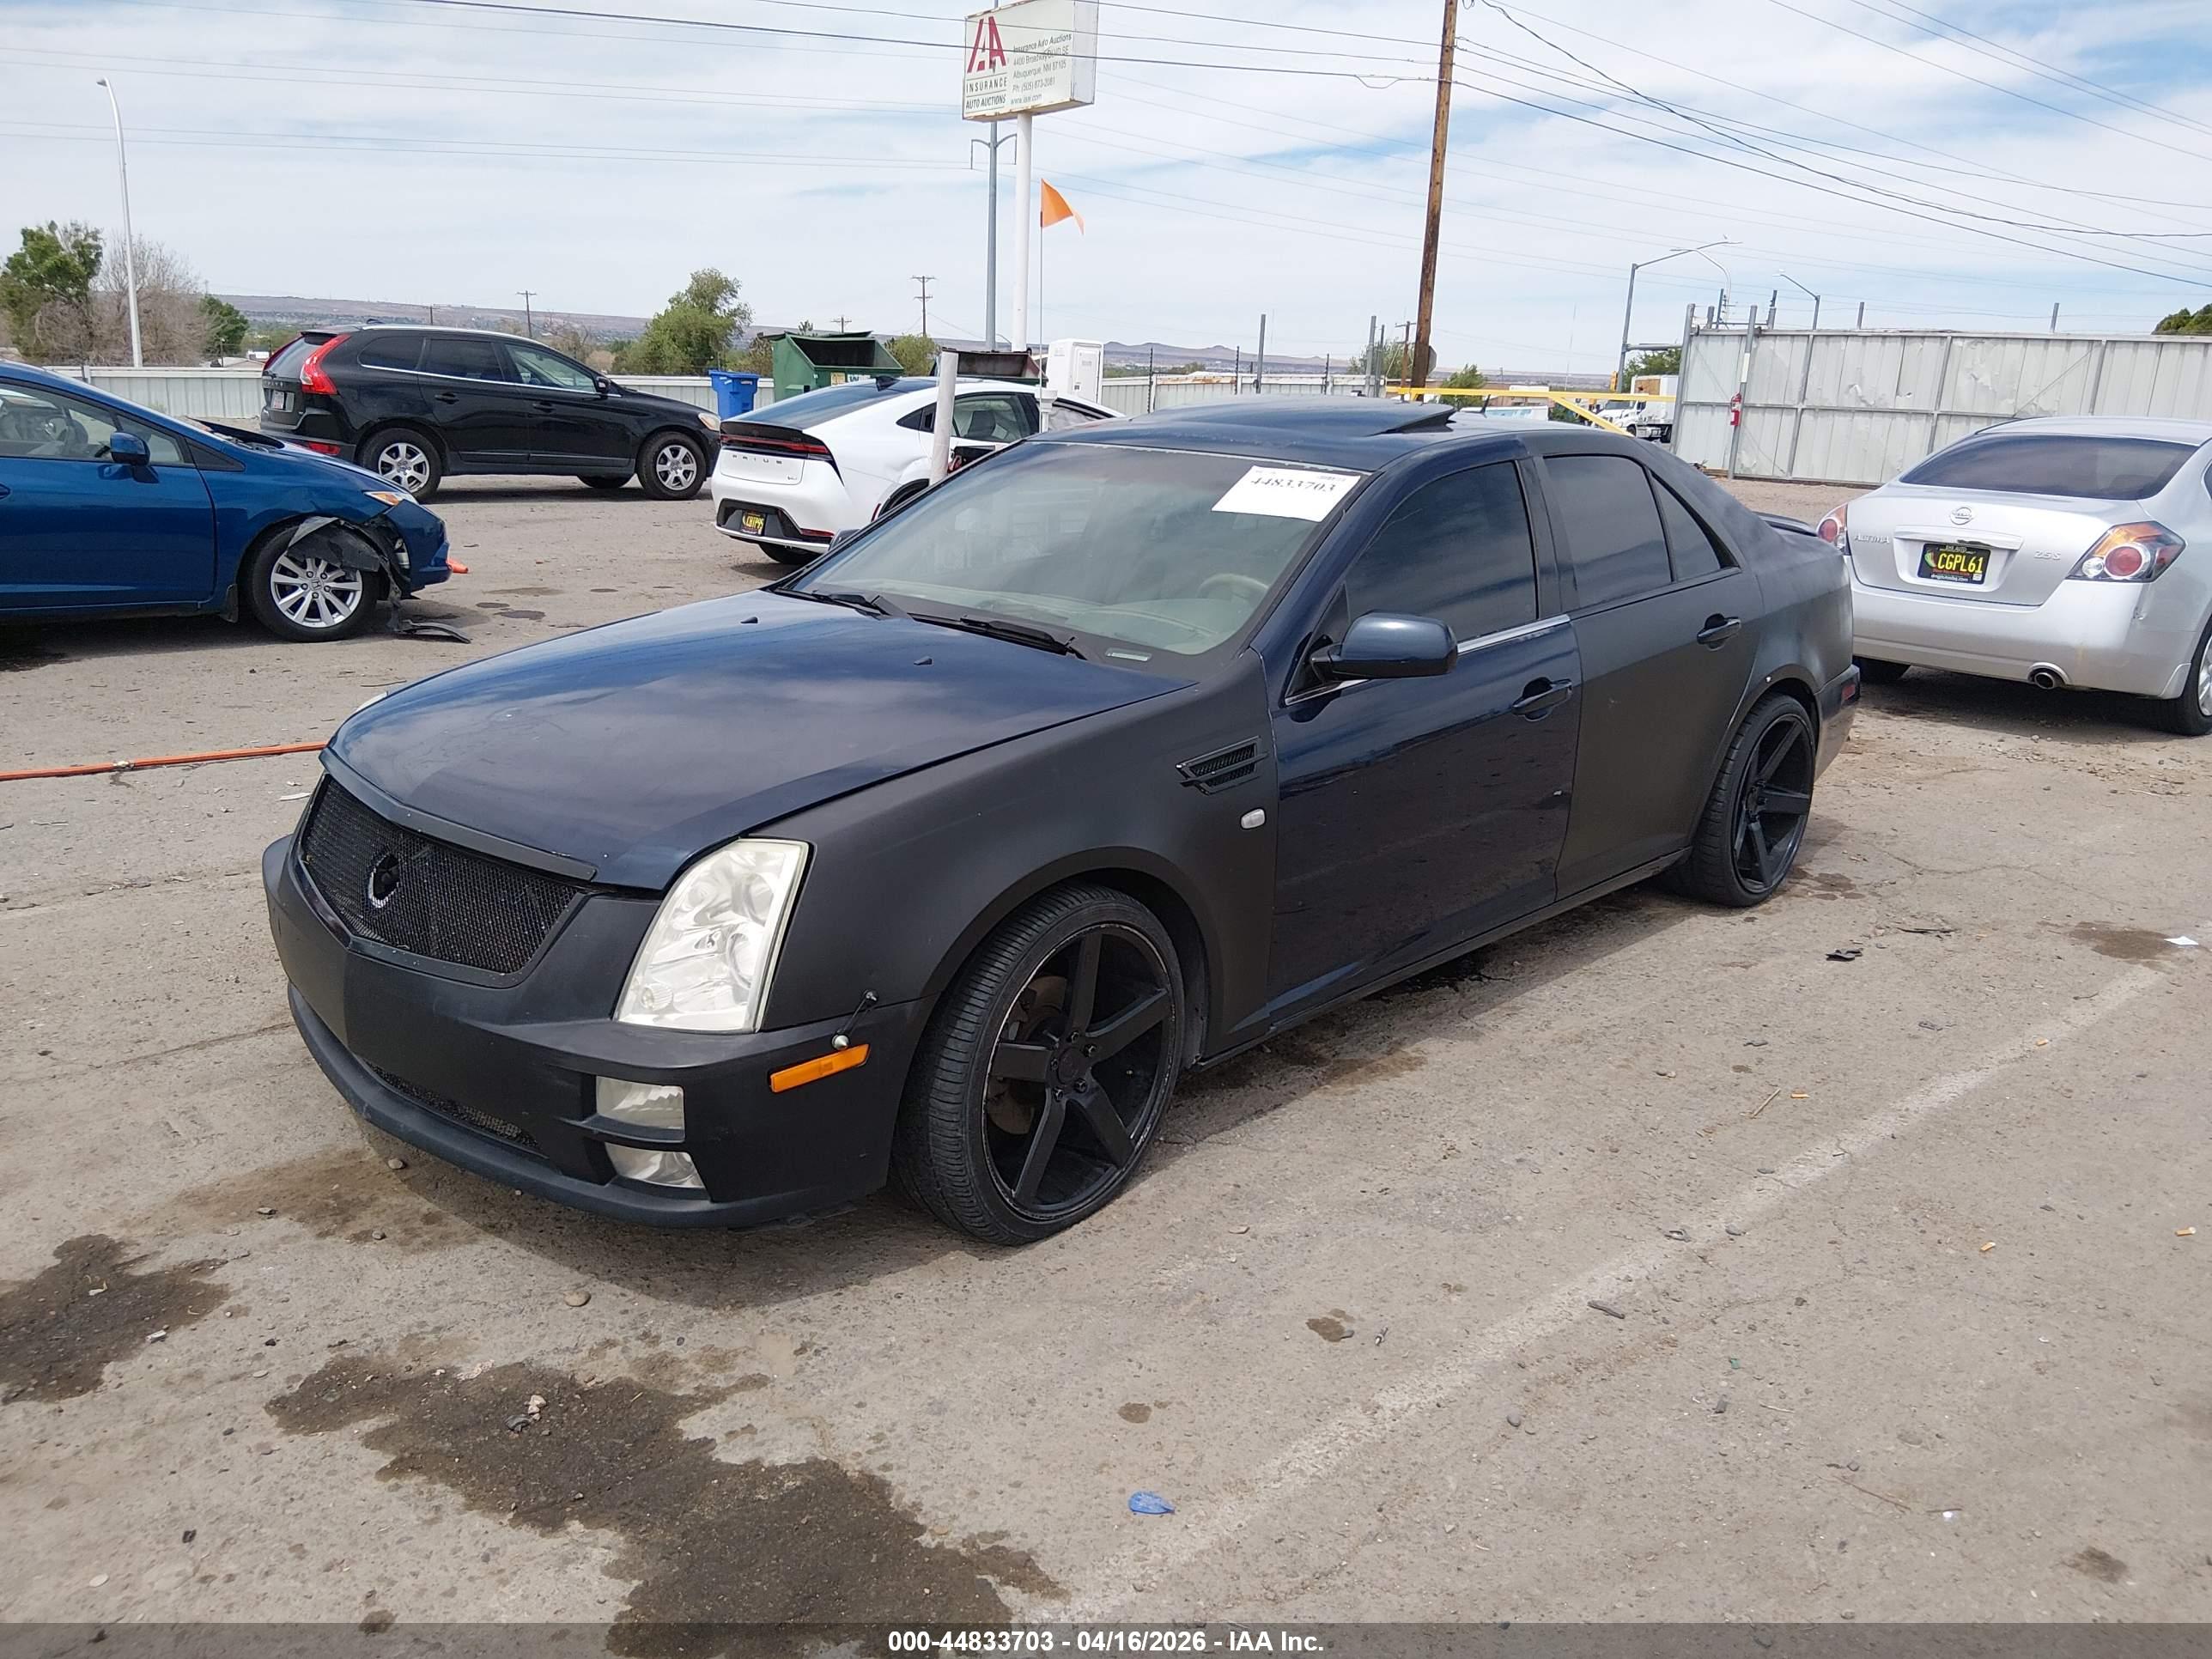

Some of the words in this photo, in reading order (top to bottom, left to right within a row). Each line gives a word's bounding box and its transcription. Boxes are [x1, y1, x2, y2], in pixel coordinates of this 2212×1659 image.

[1013, 40, 1036, 52] Insurance
[1037, 40, 1048, 48] Auto
[1049, 33, 1073, 45] Auctions
[966, 77, 1007, 94] INSURANCE
[966, 99, 980, 110] AUTO
[981, 95, 1006, 107] AUCTIONS
[1251, 477, 1336, 492] 44833703
[1937, 553, 1984, 574] CGPL61
